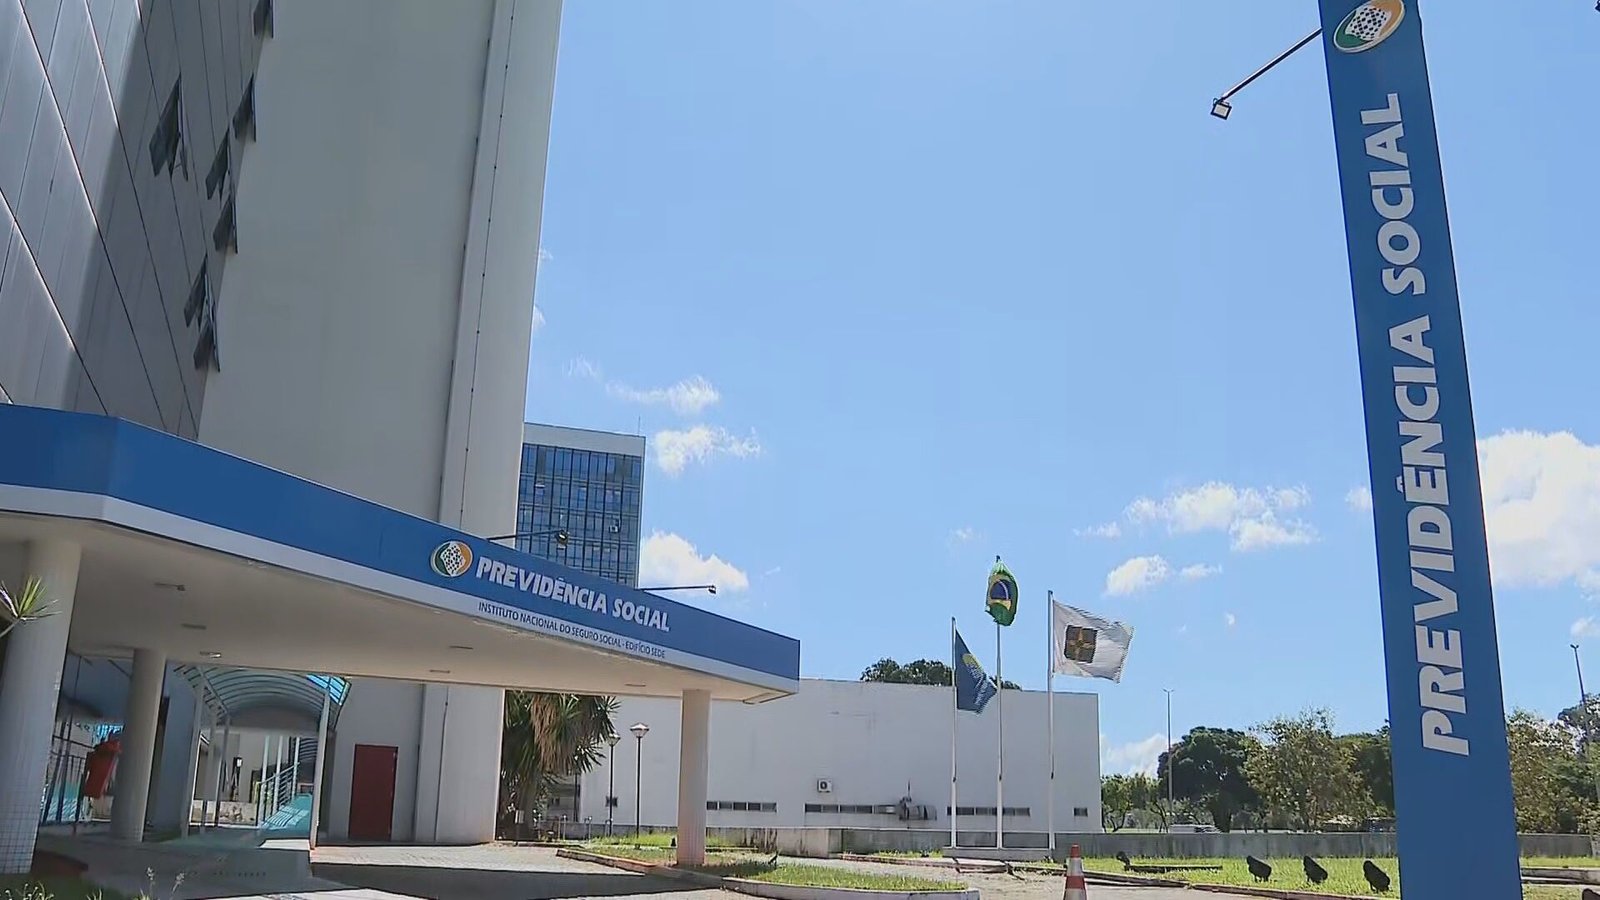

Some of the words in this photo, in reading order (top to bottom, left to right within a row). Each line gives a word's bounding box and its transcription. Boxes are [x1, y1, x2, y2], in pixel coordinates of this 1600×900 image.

[1360, 93, 1426, 295] SOCIAL
[475, 556, 608, 614] PREVIDÊNCIA
[612, 598, 671, 632] SOCIAL
[1389, 314, 1469, 756] PREVIDÊNCIA
[478, 601, 519, 621] INSTITUTO
[520, 613, 558, 631] NACIONAL
[559, 623, 571, 634] DO
[571, 626, 599, 641] SEGURO
[599, 634, 622, 648] SOCIAL
[625, 641, 651, 655] EDIFÍCIO
[651, 648, 665, 659] SEDE
